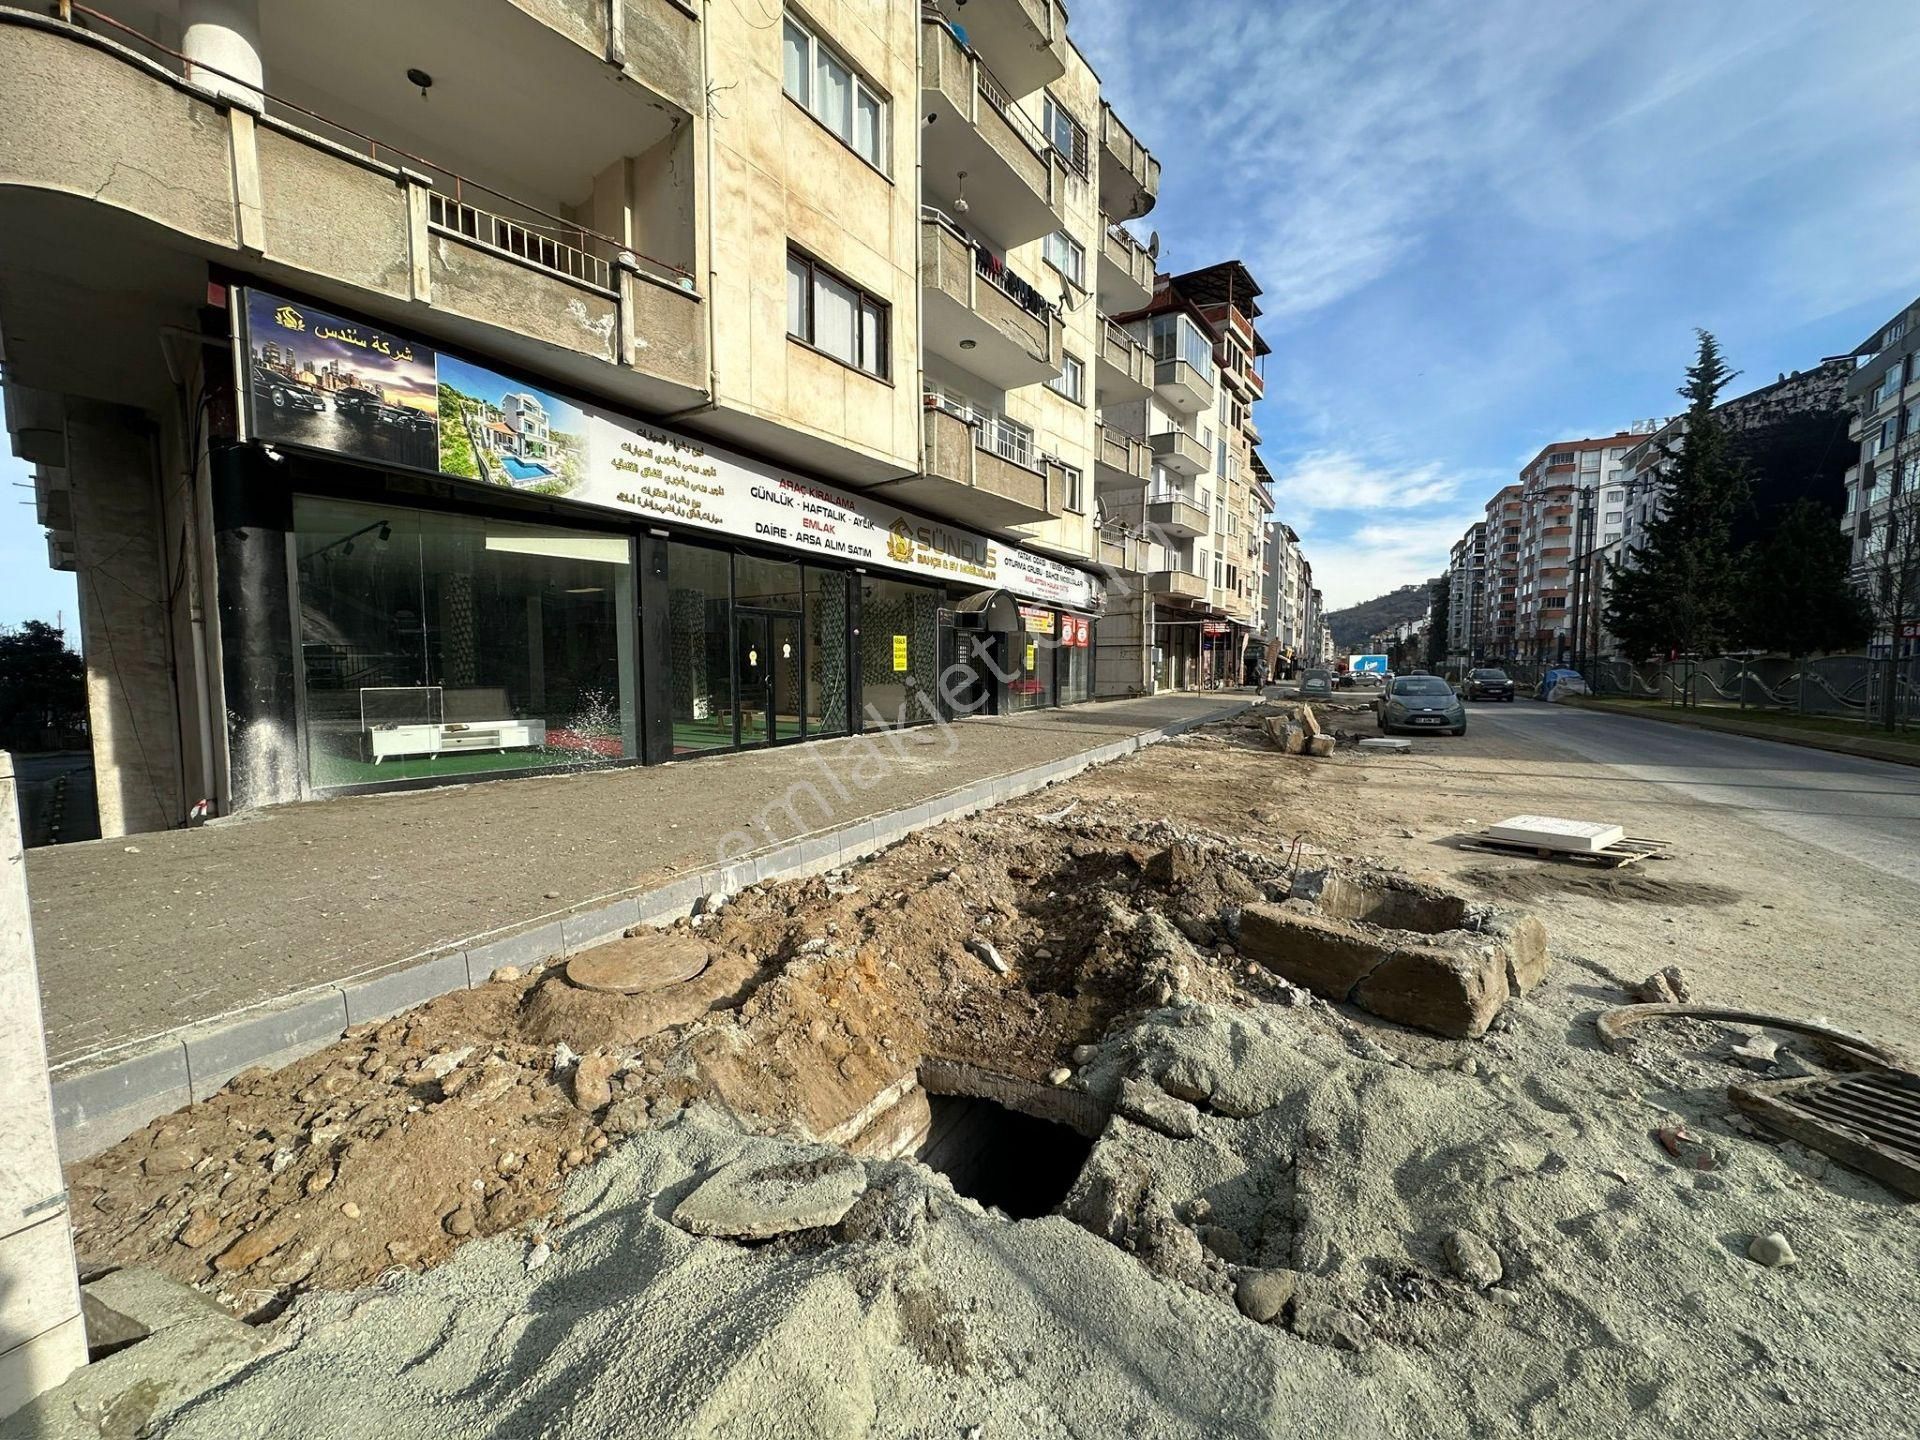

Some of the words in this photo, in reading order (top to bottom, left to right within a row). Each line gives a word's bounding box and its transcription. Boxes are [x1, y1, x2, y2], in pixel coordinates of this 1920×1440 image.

[371, 334, 414, 362] شركة
[779, 478, 806, 498] ARAÇ
[750, 485, 794, 508] GÜNLÜK
[802, 501, 846, 523] HAFTALIK
[853, 516, 875, 531] AYLIK
[755, 522, 787, 539] DAİRE
[796, 531, 822, 547] ARSA
[824, 538, 846, 553] ALIM
[847, 544, 872, 558] SATIM
[802, 517, 836, 535] EMLAK
[917, 526, 997, 569] SÜNDUS
